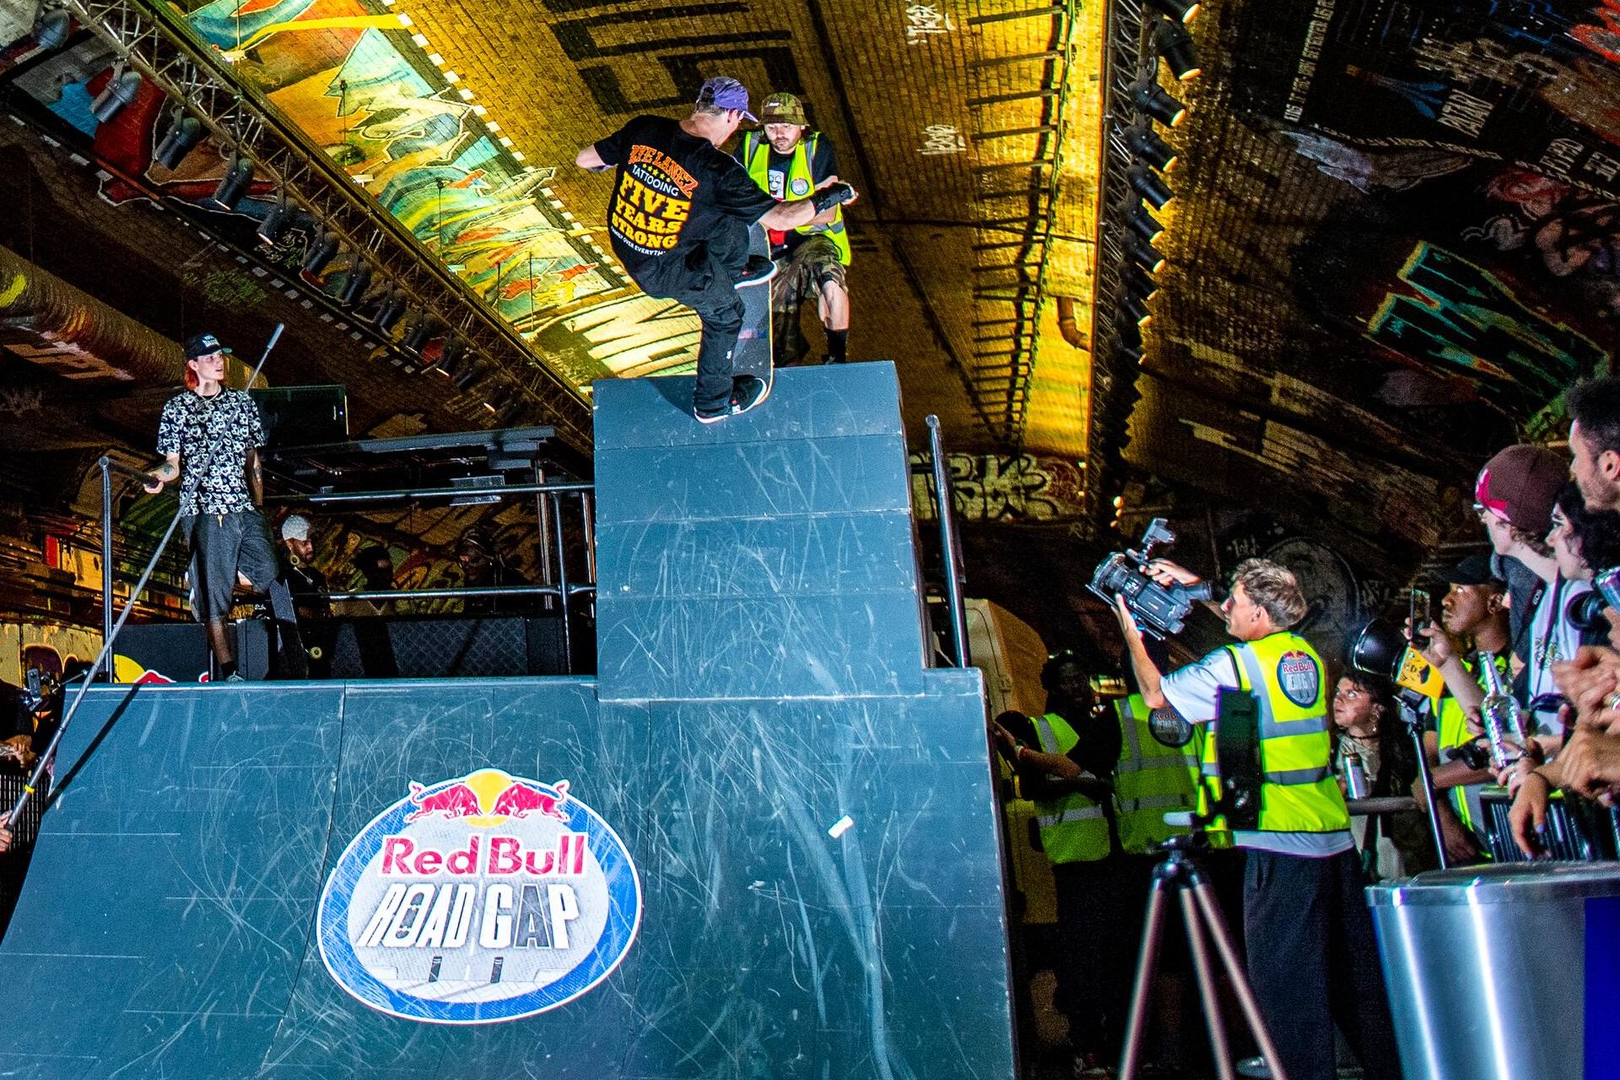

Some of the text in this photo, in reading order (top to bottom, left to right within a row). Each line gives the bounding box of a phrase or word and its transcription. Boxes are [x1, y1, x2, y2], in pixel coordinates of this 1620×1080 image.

[619, 170, 692, 221] FIVE
[632, 164, 679, 197] TATTOOING
[611, 211, 678, 249] STRONG
[615, 194, 684, 235] YEARS
[381, 835, 586, 875] Red Bull
[355, 882, 580, 949] ROAD GAP
